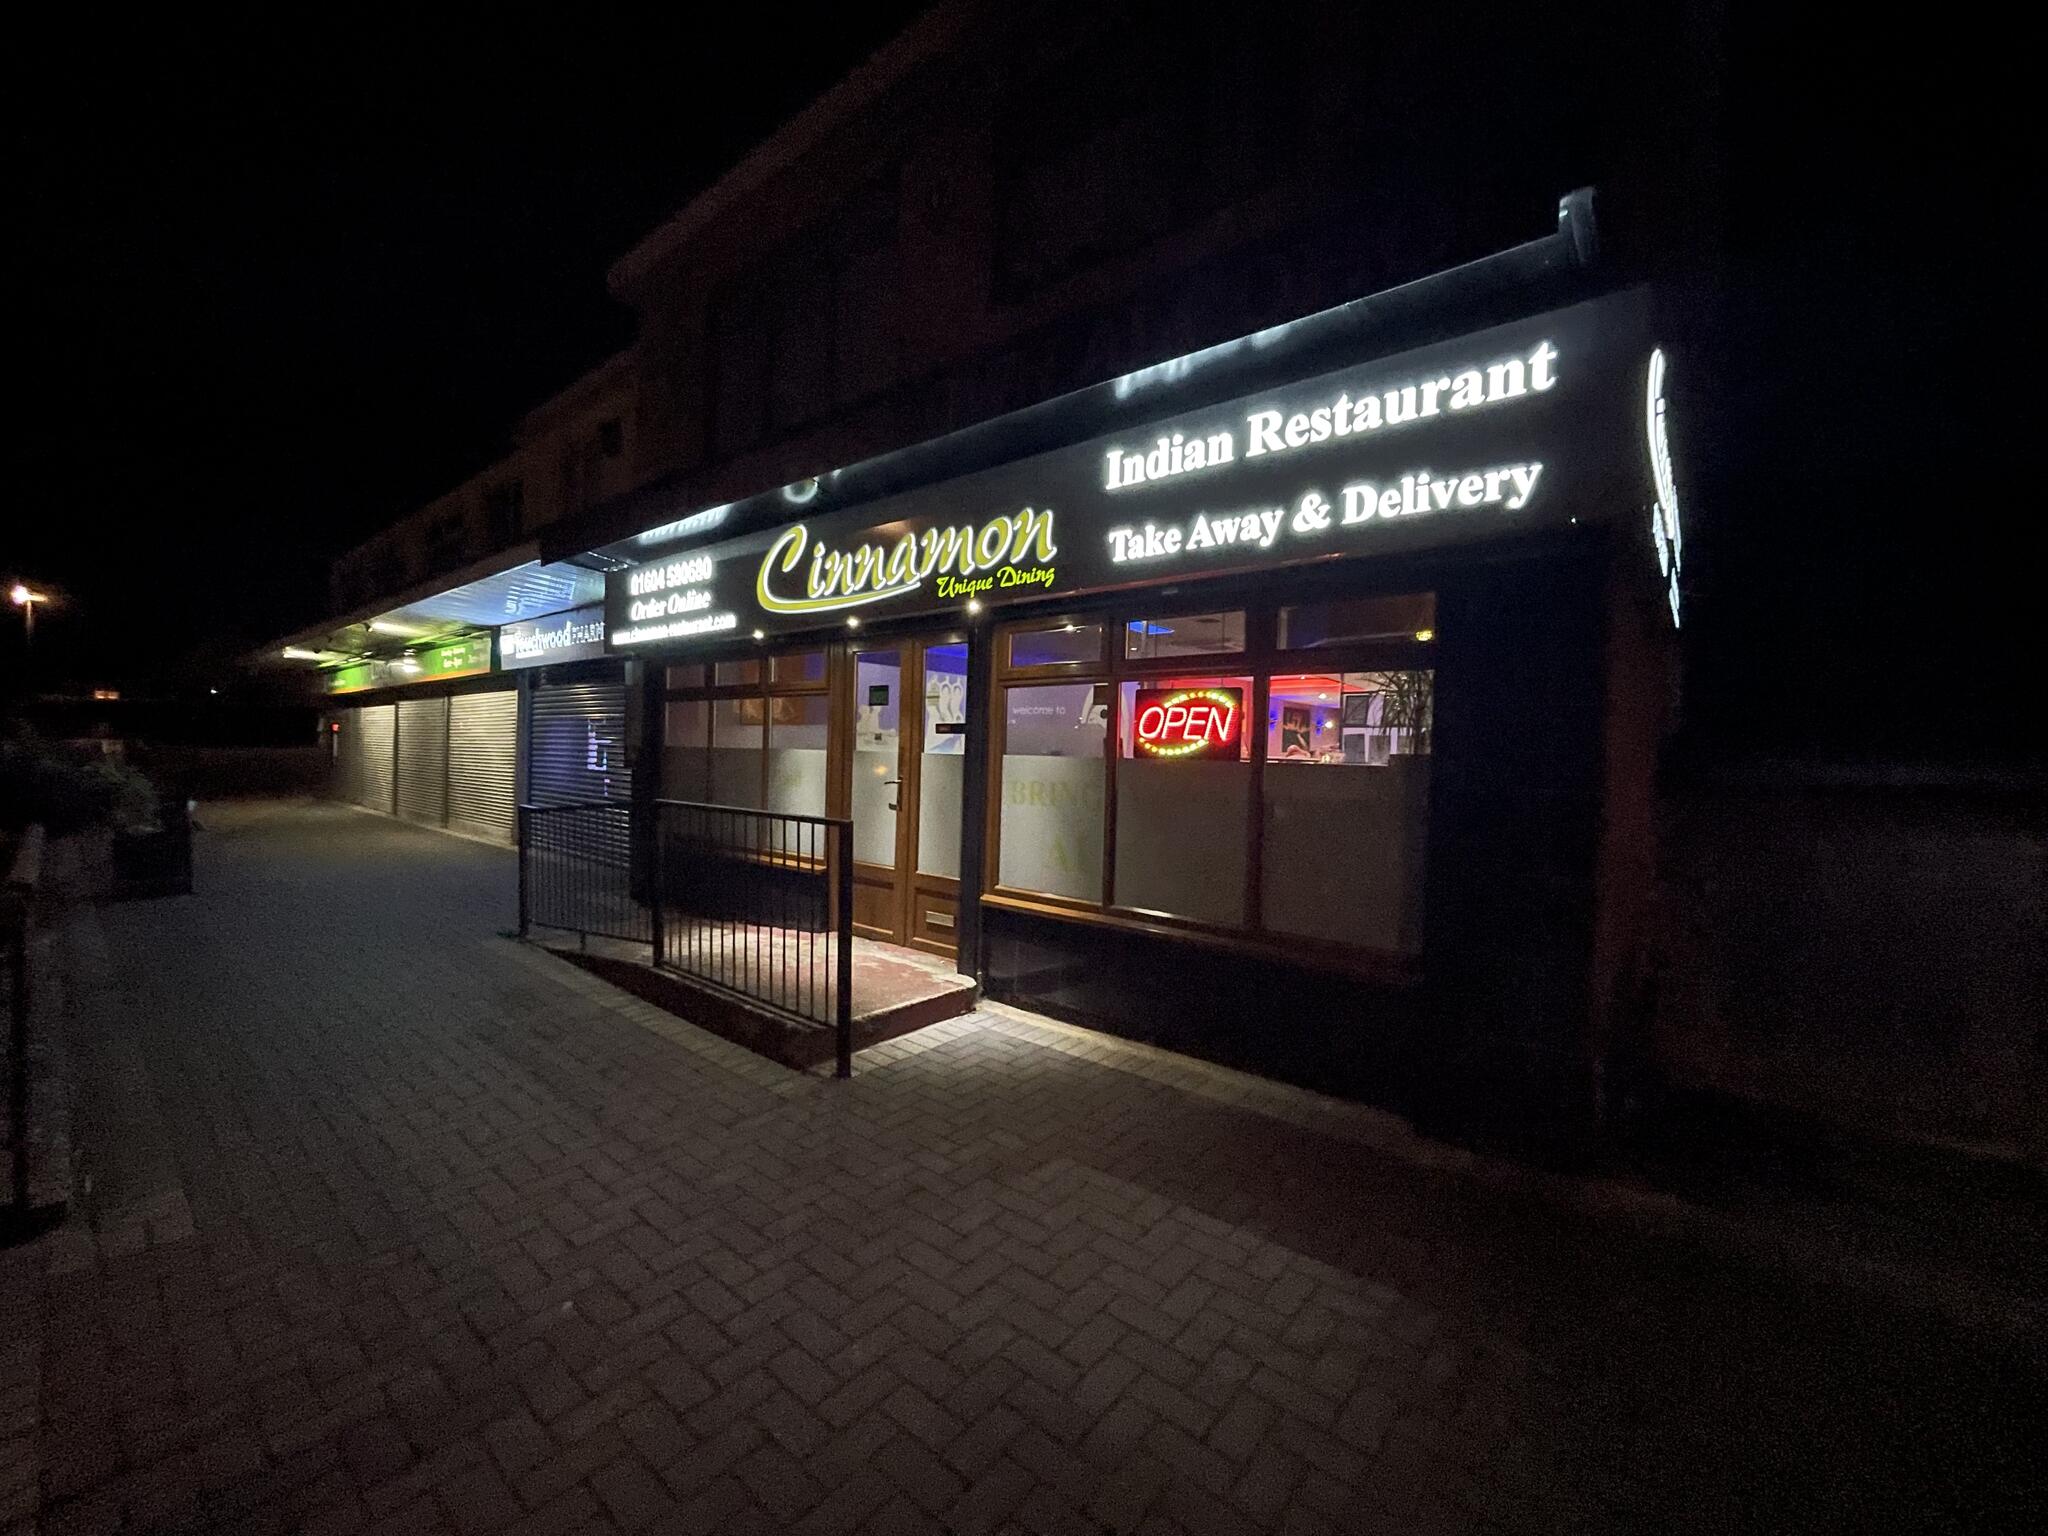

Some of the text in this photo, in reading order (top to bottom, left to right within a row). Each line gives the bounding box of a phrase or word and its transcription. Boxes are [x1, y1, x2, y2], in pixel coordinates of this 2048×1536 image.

[1105, 340, 1557, 490] Indian Restaurant
[1109, 462, 1543, 562] Take Away & Delivery
[756, 507, 1058, 614] Cinnamon
[630, 566, 665, 596] 01604
[936, 565, 1056, 598] Unique Dining
[631, 589, 712, 621] Order Online
[1012, 704, 1066, 716] welcome to
[1138, 706, 1234, 742] OPEN
